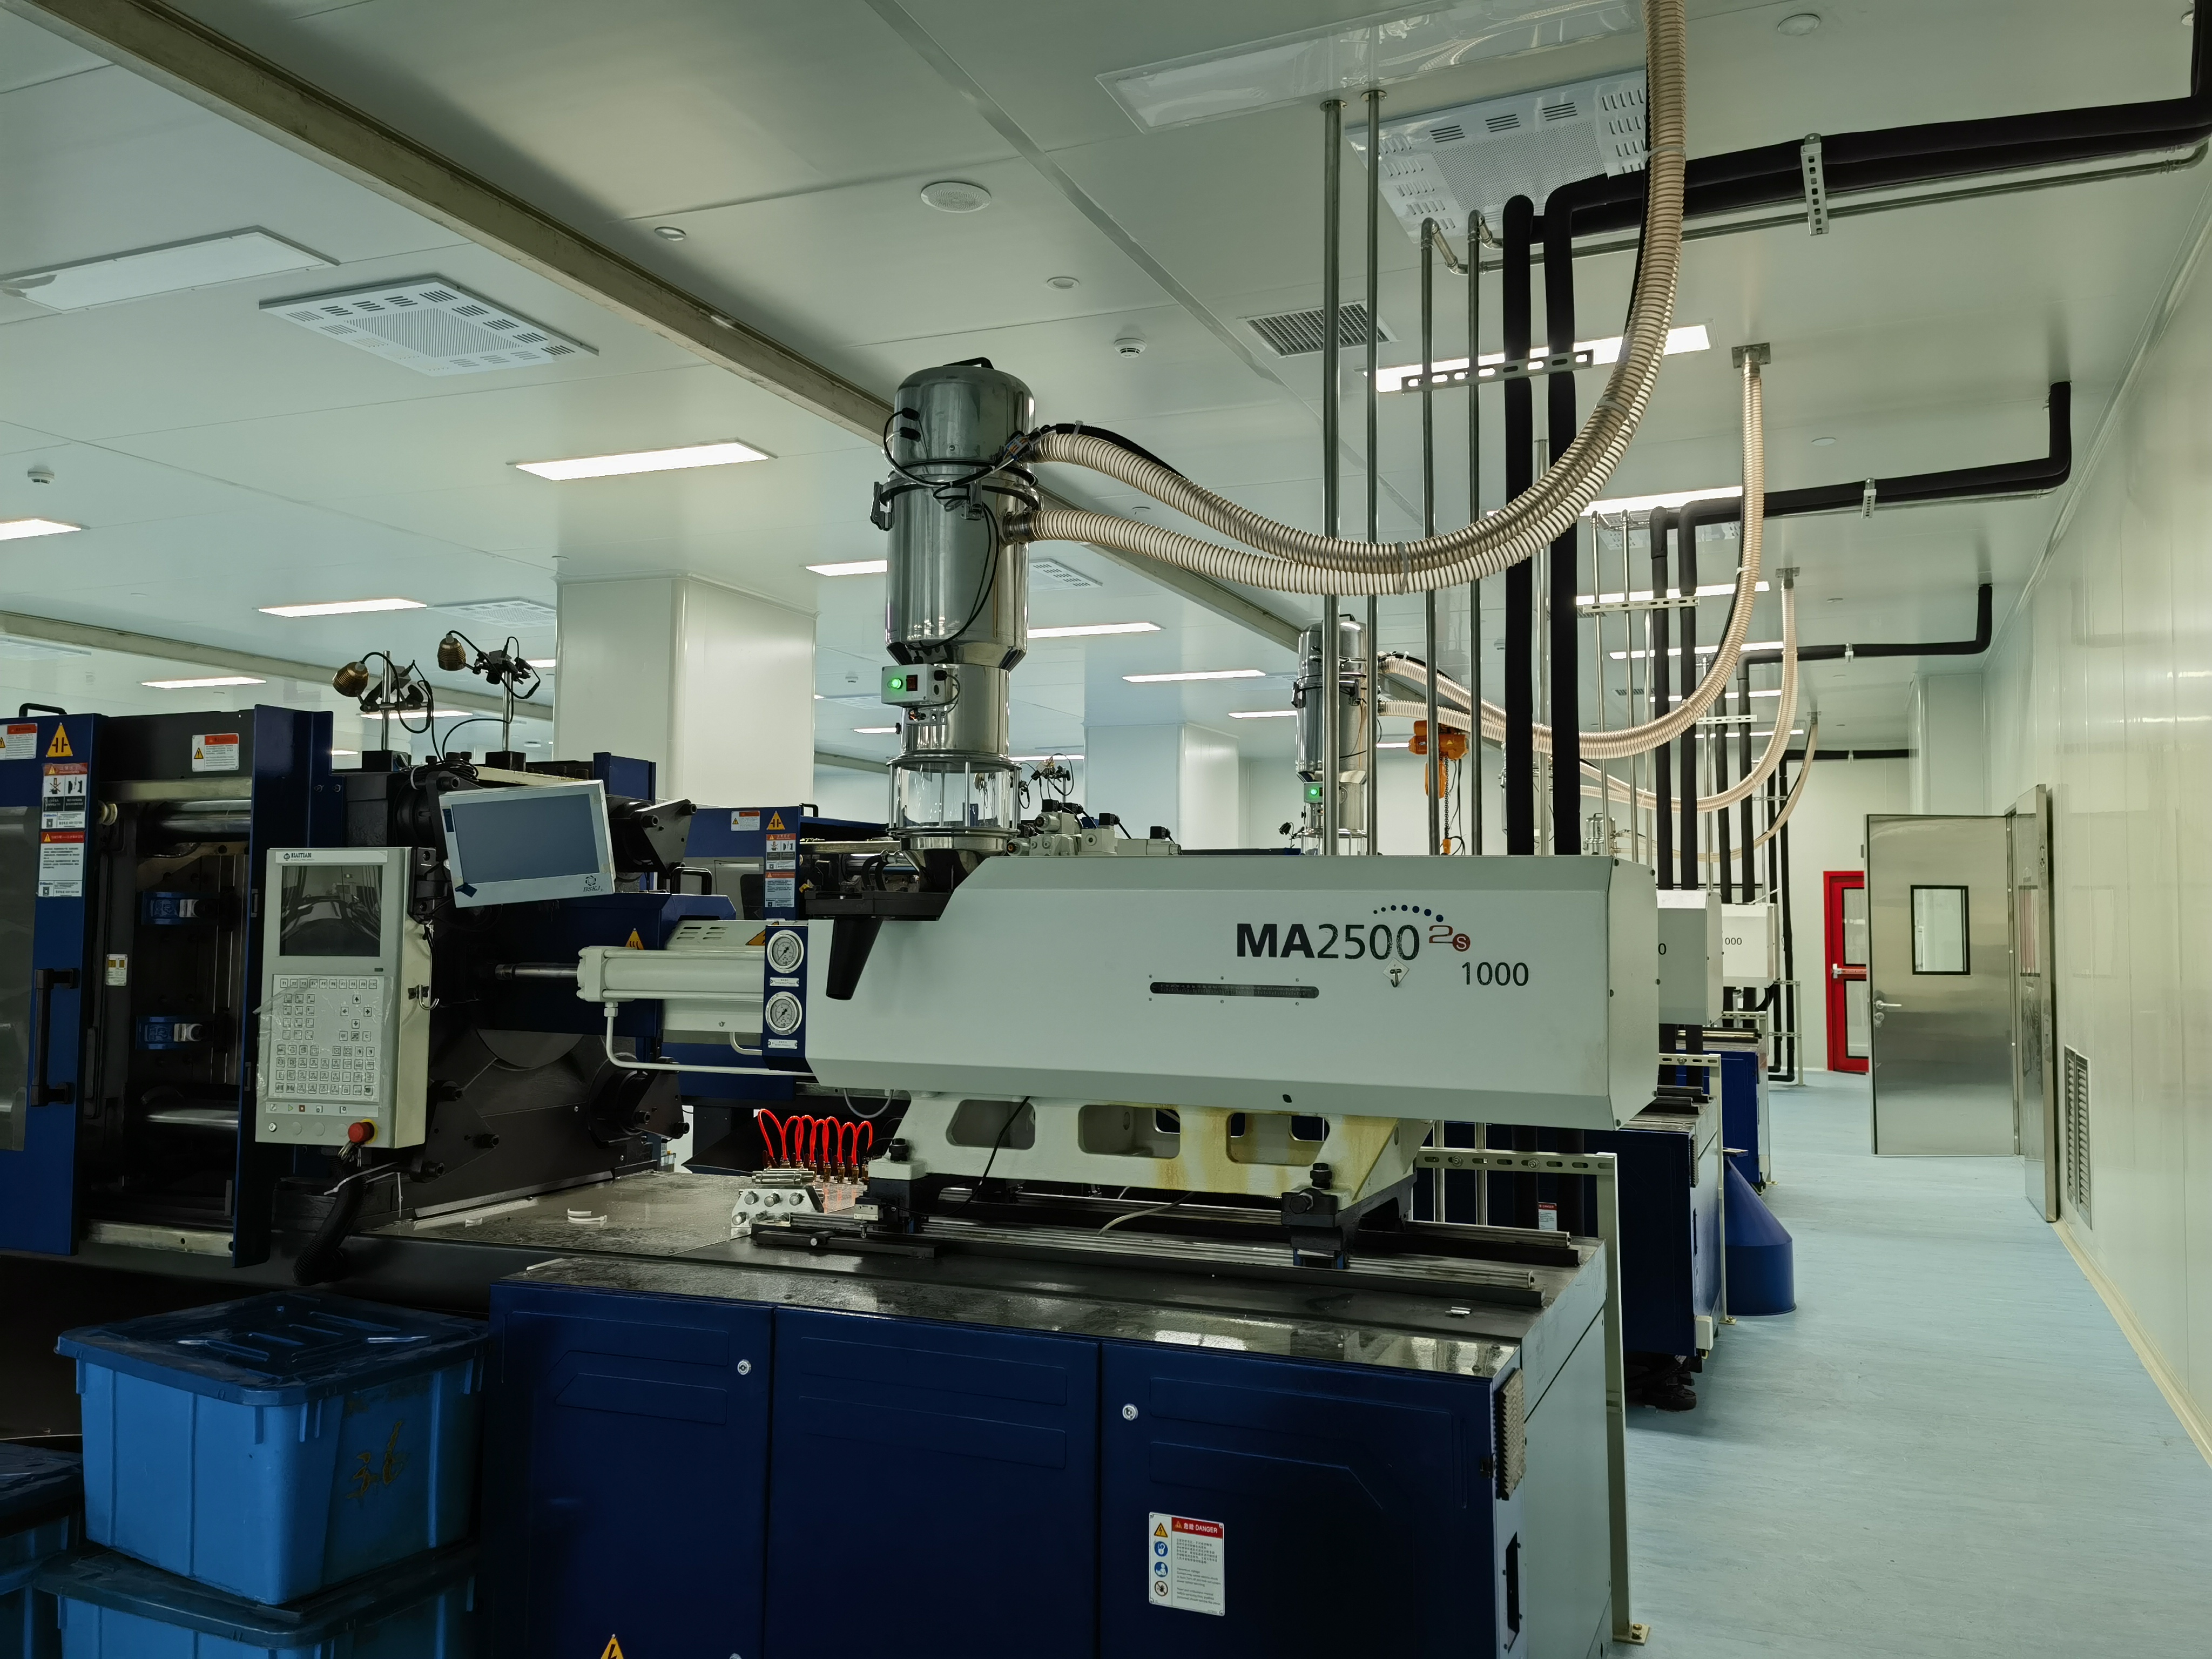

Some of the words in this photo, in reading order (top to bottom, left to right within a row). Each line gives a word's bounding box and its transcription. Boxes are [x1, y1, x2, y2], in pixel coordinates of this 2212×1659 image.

[1237, 923, 1420, 961] MA2500
[1462, 961, 1529, 986] 1000
[1195, 1525, 1218, 1534] DANGER
